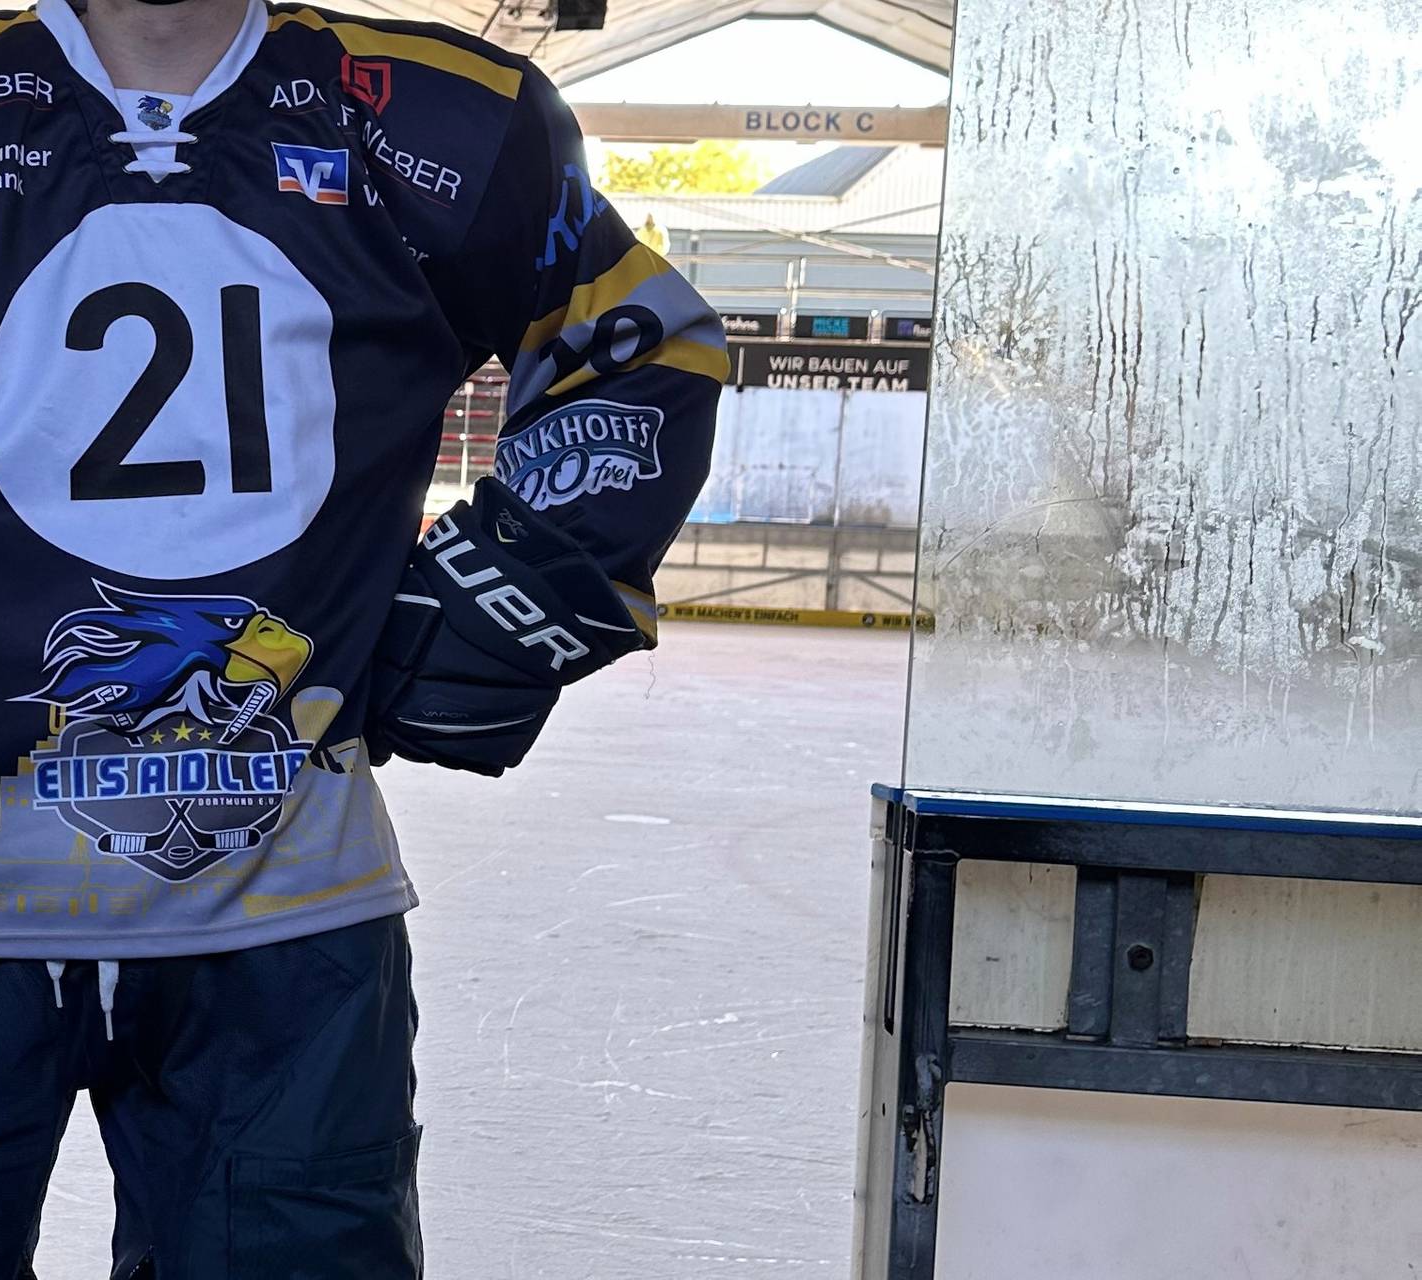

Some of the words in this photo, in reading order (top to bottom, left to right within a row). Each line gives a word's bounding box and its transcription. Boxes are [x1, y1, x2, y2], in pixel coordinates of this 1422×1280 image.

[745, 111, 841, 132] BLOCK
[856, 112, 875, 133] C
[769, 355, 805, 372] WIR
[808, 356, 869, 374] BAUEN
[872, 359, 910, 375] AUF
[65, 281, 272, 501] 21
[767, 373, 841, 390] UNSER
[847, 376, 909, 392] TEAM
[592, 456, 634, 490] frei
[422, 512, 590, 672] AUER
[197, 796, 254, 807] DORTMUND
